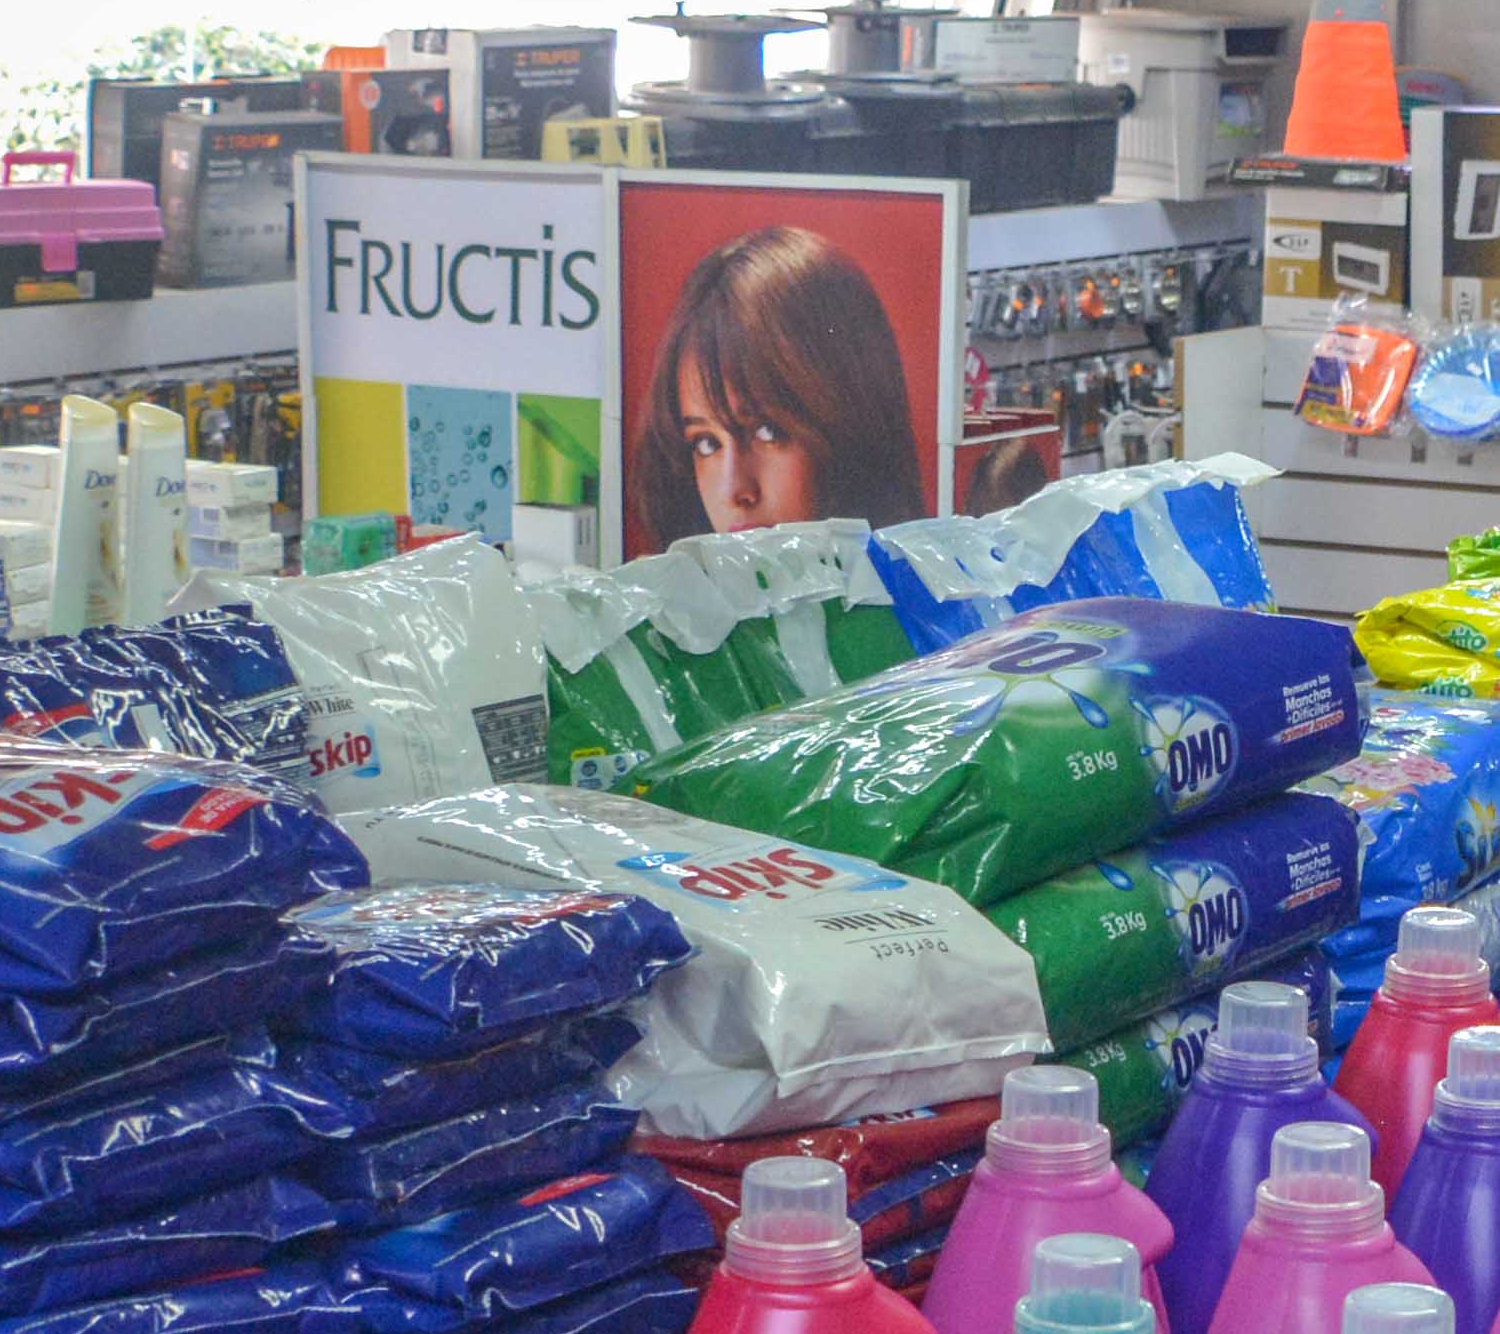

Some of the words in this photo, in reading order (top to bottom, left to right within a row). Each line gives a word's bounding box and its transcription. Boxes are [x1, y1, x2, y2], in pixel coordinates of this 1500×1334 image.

[325, 219, 599, 331] FRUCTiS
[309, 731, 373, 778] skip
[1169, 722, 1233, 793] OMO
[1190, 888, 1243, 955] OMO
